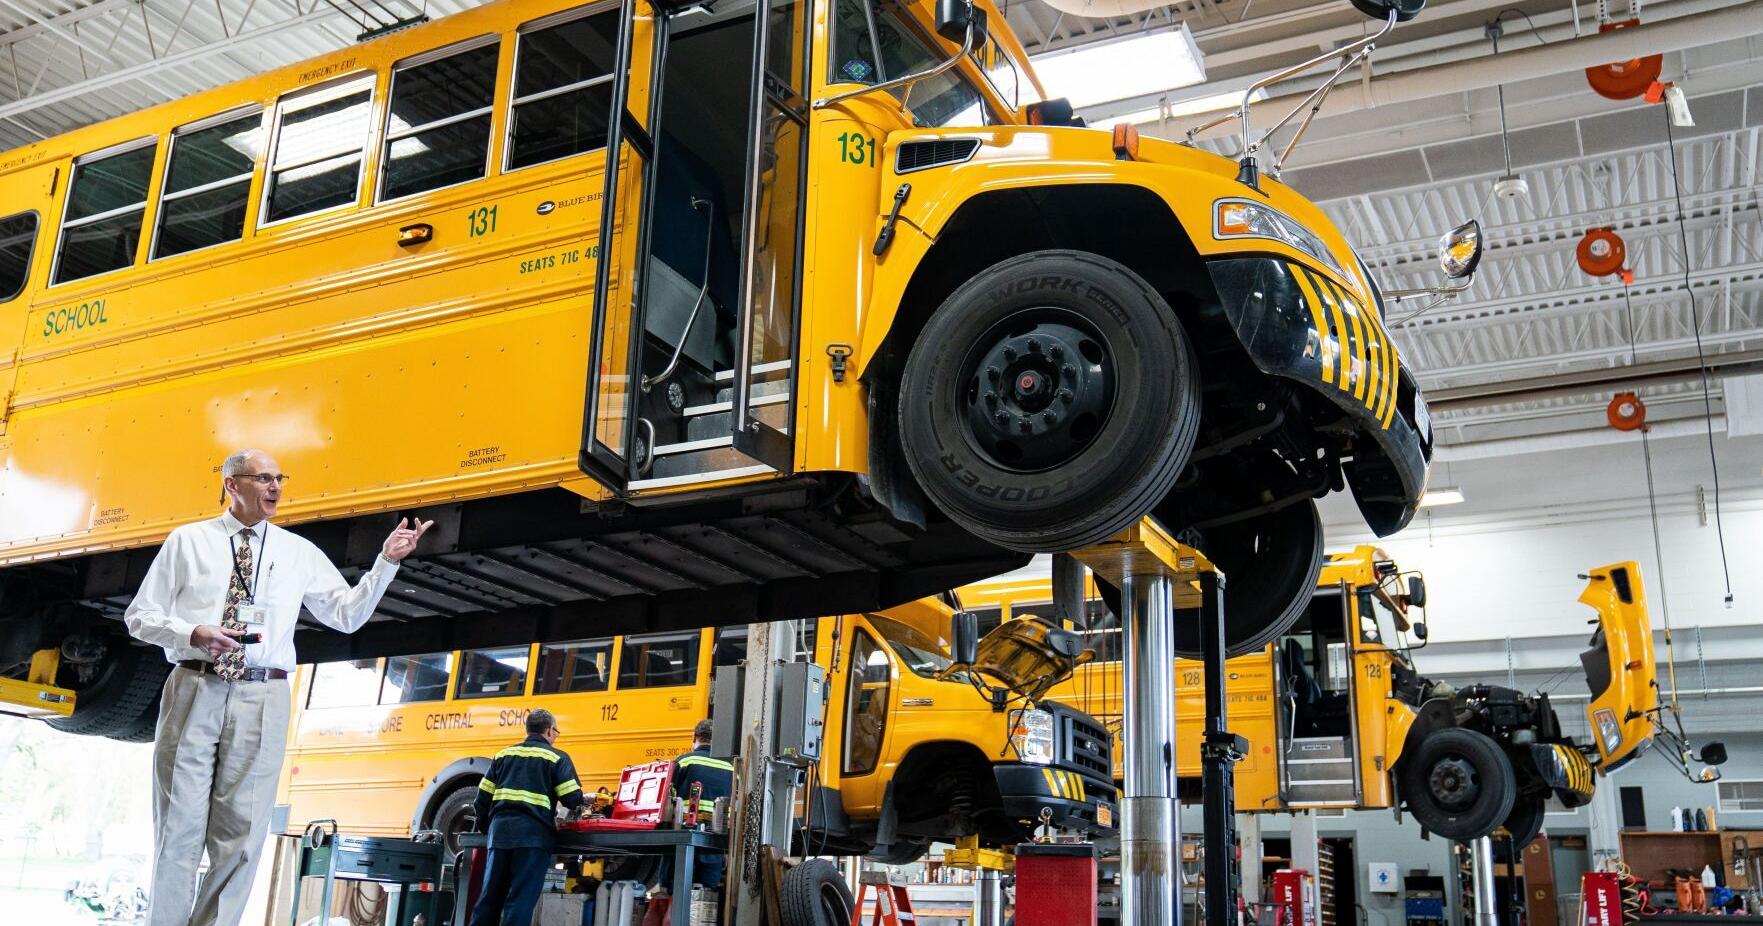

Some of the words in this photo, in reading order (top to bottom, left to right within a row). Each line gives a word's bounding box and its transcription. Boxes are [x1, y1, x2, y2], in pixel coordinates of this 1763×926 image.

[837, 132, 876, 168] 131
[558, 196, 584, 208] BLUE
[587, 192, 603, 202] BIR
[468, 204, 497, 237] 131
[520, 256, 555, 274] SEATS
[561, 250, 579, 265] 71C
[584, 246, 599, 259] 48
[44, 299, 108, 336] SCHOOL
[468, 446, 500, 457] BATTERY
[460, 454, 506, 467] DISCONNECT
[940, 454, 1074, 502] COOPER
[94, 514, 129, 526] DISCONNECT
[100, 508, 125, 517] BATTERY
[1183, 672, 1200, 686] 128
[1364, 664, 1381, 678] 128
[426, 713, 474, 730] CENTRAL
[499, 708, 531, 726] SCHO
[601, 703, 618, 721] 112
[645, 748, 665, 757] SEATS
[1284, 885, 1293, 902] LIFT
[1598, 888, 1607, 907] LIFT
